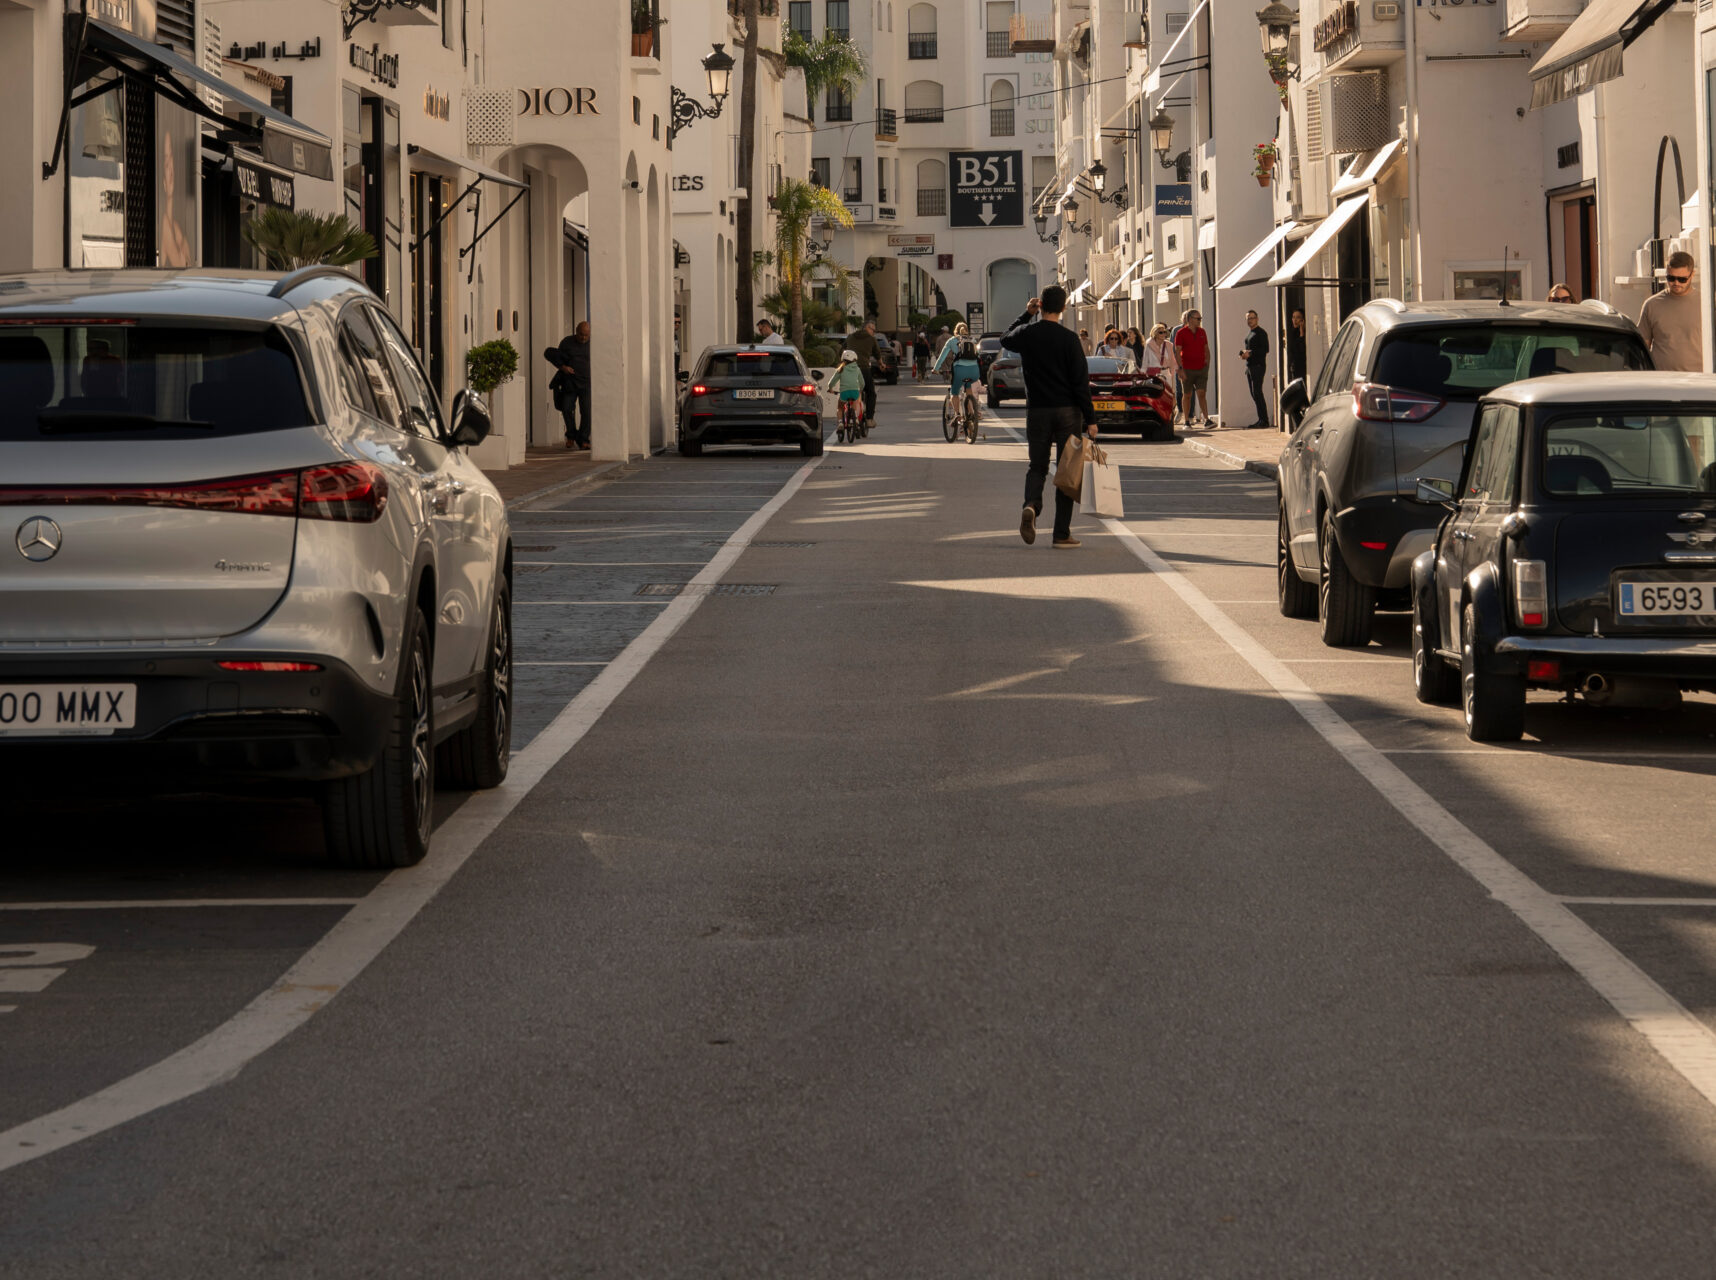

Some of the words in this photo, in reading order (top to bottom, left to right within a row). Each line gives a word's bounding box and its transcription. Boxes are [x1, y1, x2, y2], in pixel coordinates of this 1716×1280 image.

[957, 155, 1016, 187] B51
[957, 187, 992, 195] BOUTIQUE
[993, 186, 1017, 194] HOTEL
[901, 246, 930, 254] SUBWAY
[1641, 587, 1703, 611] 6593
[56, 691, 124, 723] MMX
